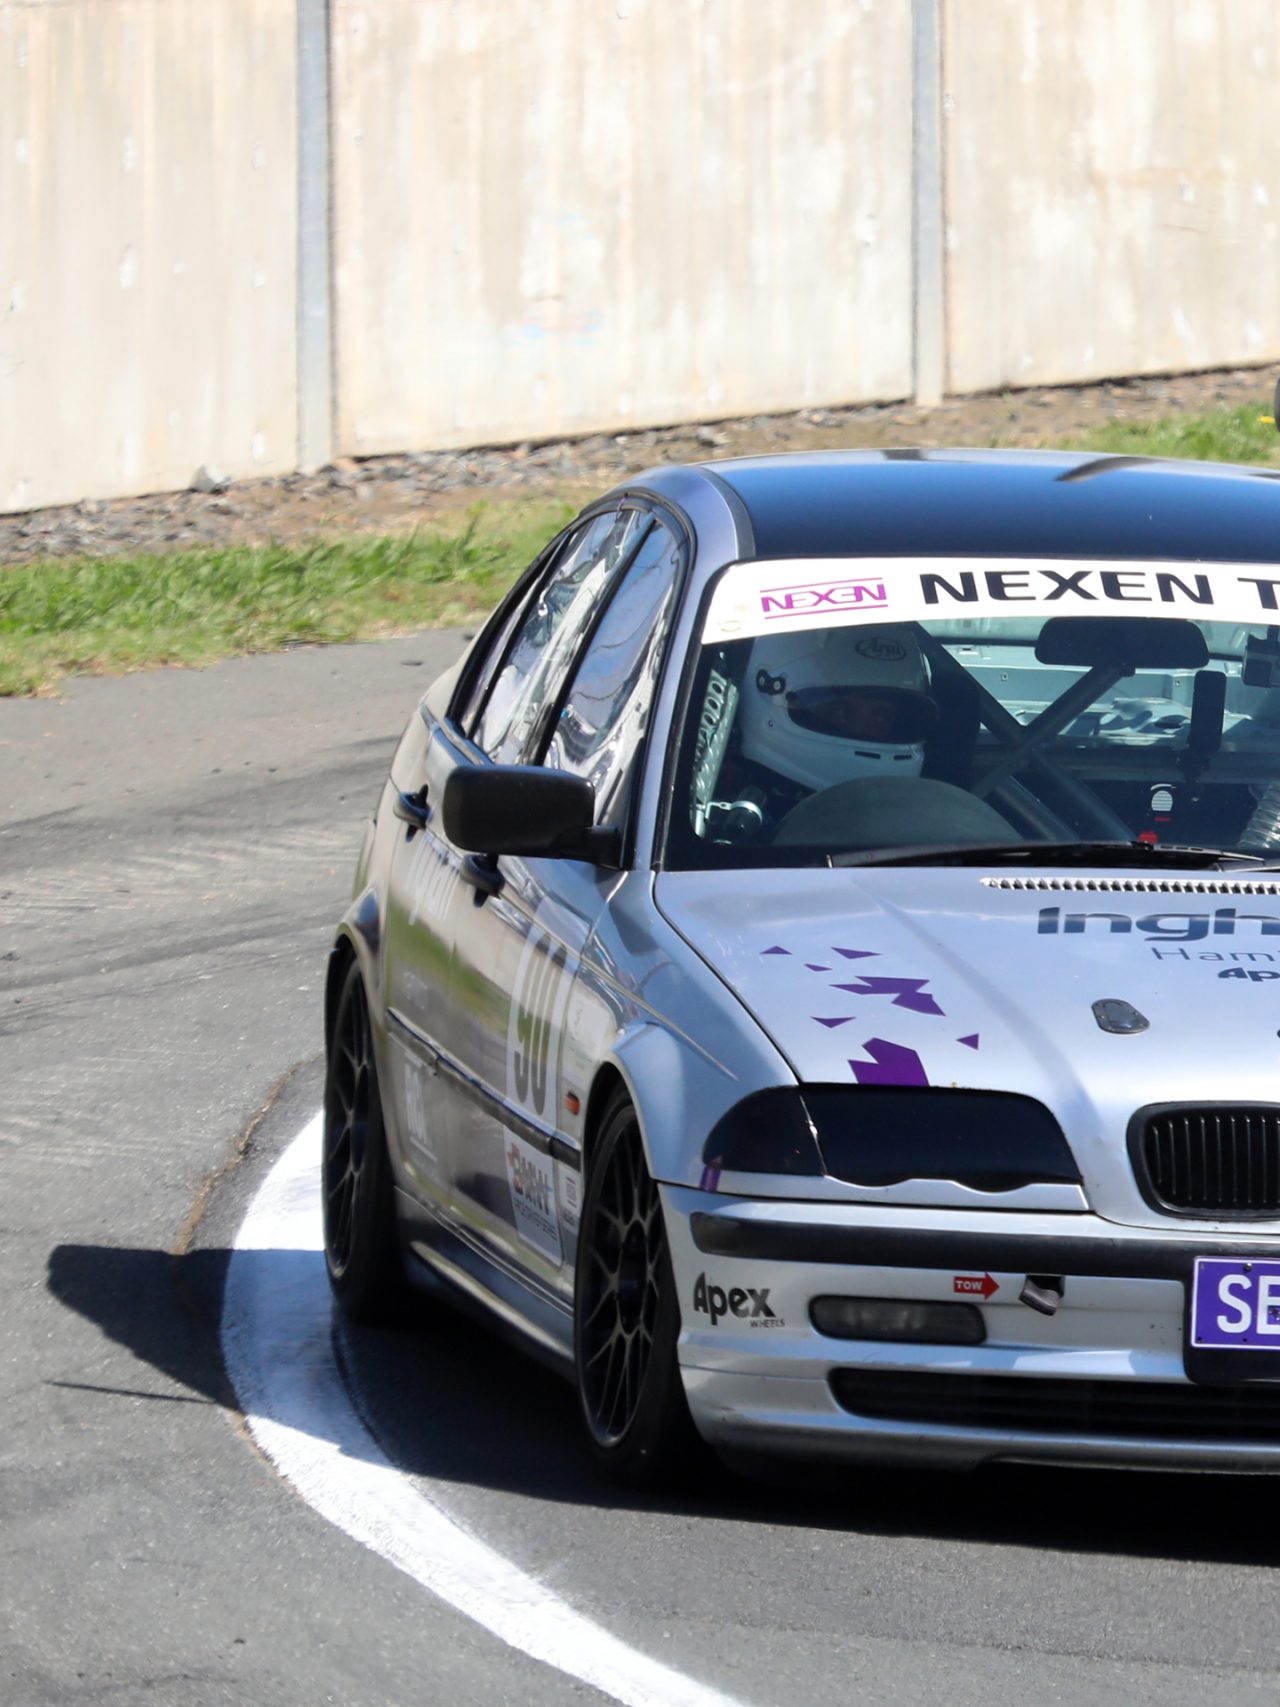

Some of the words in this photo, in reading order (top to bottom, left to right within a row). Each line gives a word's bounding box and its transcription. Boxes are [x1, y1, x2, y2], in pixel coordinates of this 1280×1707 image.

[761, 582, 888, 613] NEXEN
[919, 569, 1215, 606] NEXEN
[693, 1272, 777, 1326] Apex
[955, 1280, 983, 1291] TOW
